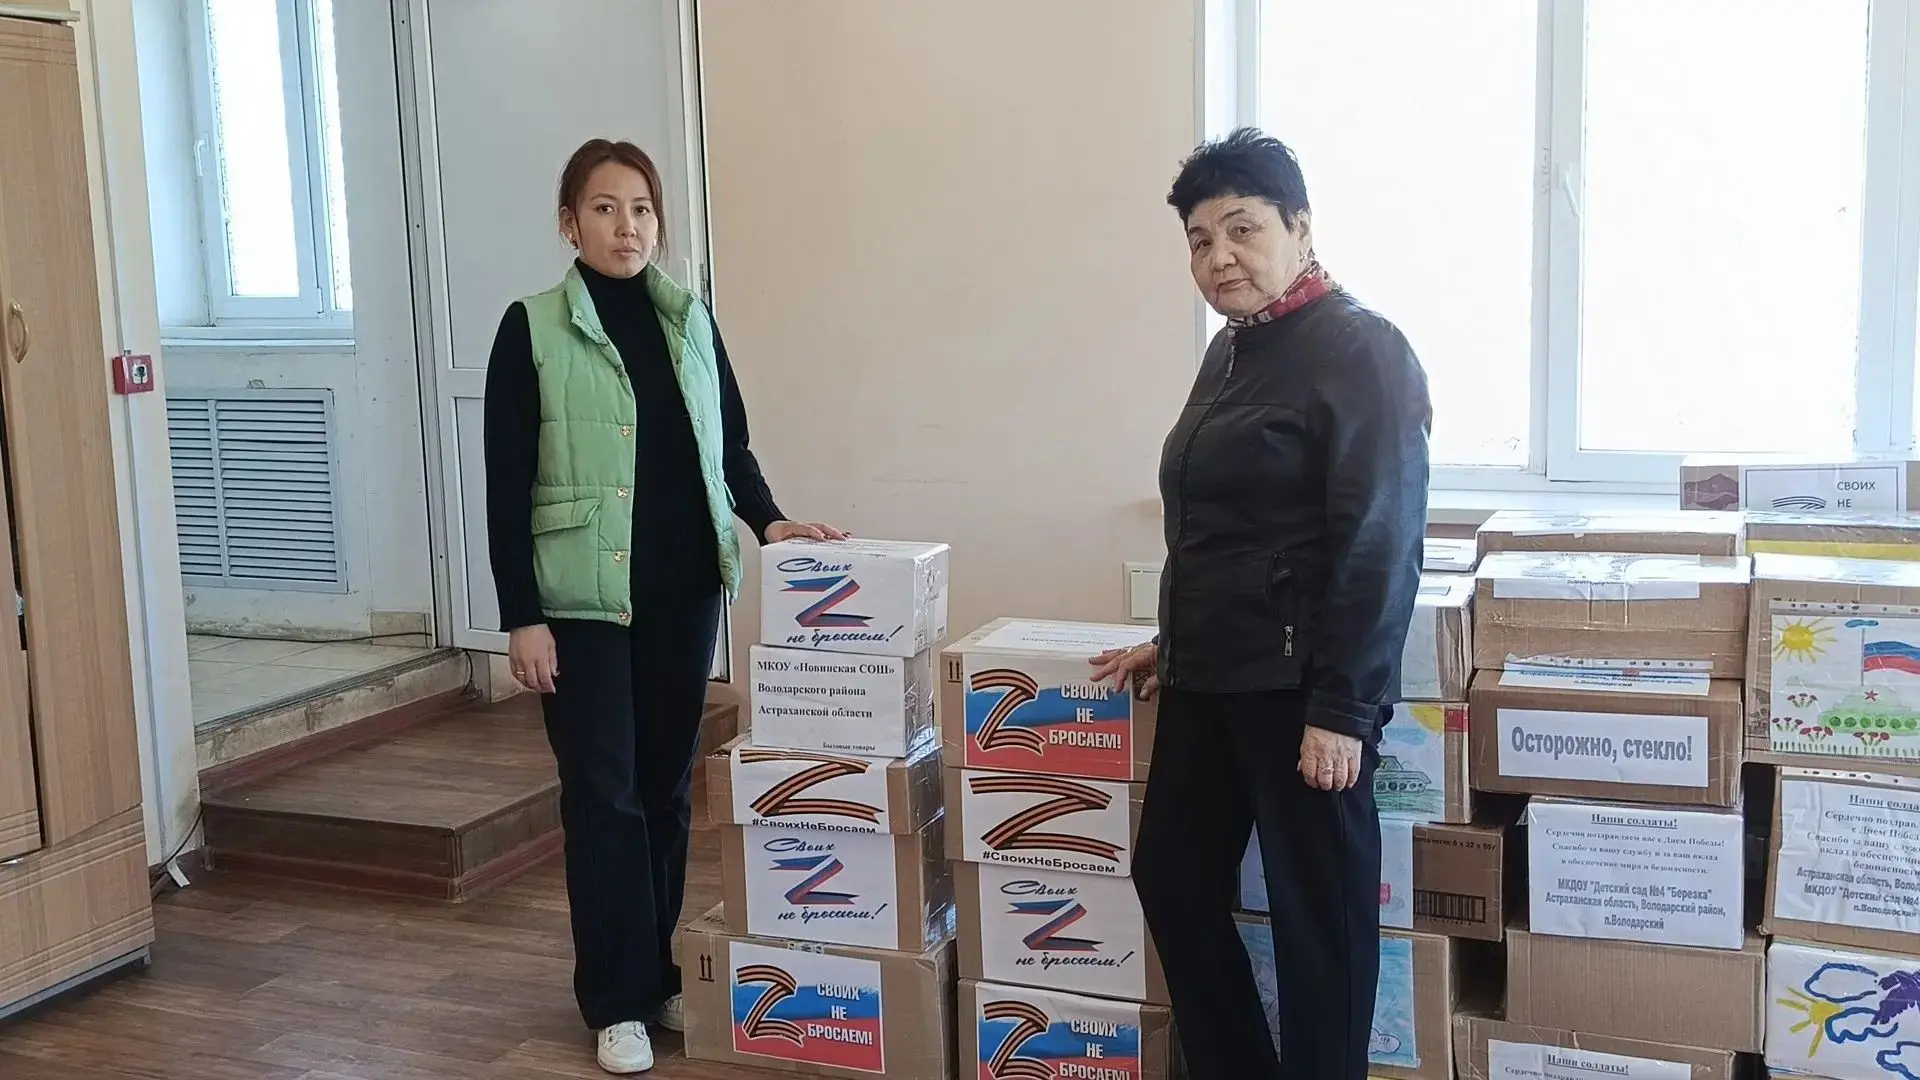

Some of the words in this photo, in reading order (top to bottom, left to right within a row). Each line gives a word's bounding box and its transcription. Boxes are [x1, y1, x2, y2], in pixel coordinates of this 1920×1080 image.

[1836, 481, 1876, 491] СВОИХ
[1837, 498, 1852, 508] НЕ
[776, 557, 853, 573] Своих
[787, 633, 808, 643] не
[811, 625, 905, 647] бросаем!
[757, 661, 791, 672] МКОУ
[794, 662, 857, 674] «Новинская
[859, 664, 895, 675] СОШ»
[758, 683, 827, 697] Володарского
[829, 687, 866, 697] района
[1060, 683, 1109, 700] СВОИХ
[758, 705, 829, 717] Астраханской
[831, 707, 873, 718] области
[1076, 707, 1094, 723] НЕ
[1048, 729, 1122, 749] БРОСАЕМ!
[1511, 726, 1617, 763] Осторожно,
[1622, 735, 1692, 761] стекло!
[1849, 794, 1884, 807] Наши
[751, 818, 876, 834] #СвоихНеБросаем
[1591, 813, 1623, 825] Наши
[1626, 816, 1677, 829] солдаты!
[1825, 810, 1874, 822] Сердечно
[1876, 817, 1920, 828] поздрав
[763, 837, 835, 852] Своих
[982, 851, 1116, 873] #СвоихНеБросаем
[1796, 866, 1854, 883] Астраханская
[1855, 872, 1892, 890] область,
[1000, 880, 1079, 895] Своих
[1558, 878, 1588, 892] МКДОУ
[1590, 880, 1629, 895] "Детский
[1631, 885, 1648, 897] сад
[1649, 884, 1665, 897] №4
[1667, 886, 1713, 901] "Березка"
[1804, 883, 1838, 898] МКДОУ
[1884, 895, 1901, 906] сад
[778, 911, 796, 920] не
[801, 903, 888, 924] бросаем!
[1545, 892, 1602, 907] Астраханская
[1603, 897, 1639, 911] область,
[1640, 898, 1696, 914] Володарский
[1698, 904, 1727, 918] район,
[1604, 914, 1664, 930] п.Володарский
[1015, 957, 1036, 966] не
[1040, 951, 1135, 970] бросаем!
[816, 983, 860, 1001] СВОИХ
[830, 1005, 848, 1021] НЕ
[807, 1023, 873, 1045] БРОСАЕМ!
[1070, 1019, 1118, 1038] СВОИХ
[1086, 1042, 1104, 1059] НЕ
[1059, 1062, 1130, 1080] БРОСАЕМ!
[1547, 1054, 1578, 1067] Наши
[1581, 1060, 1630, 1074] солдаты!
